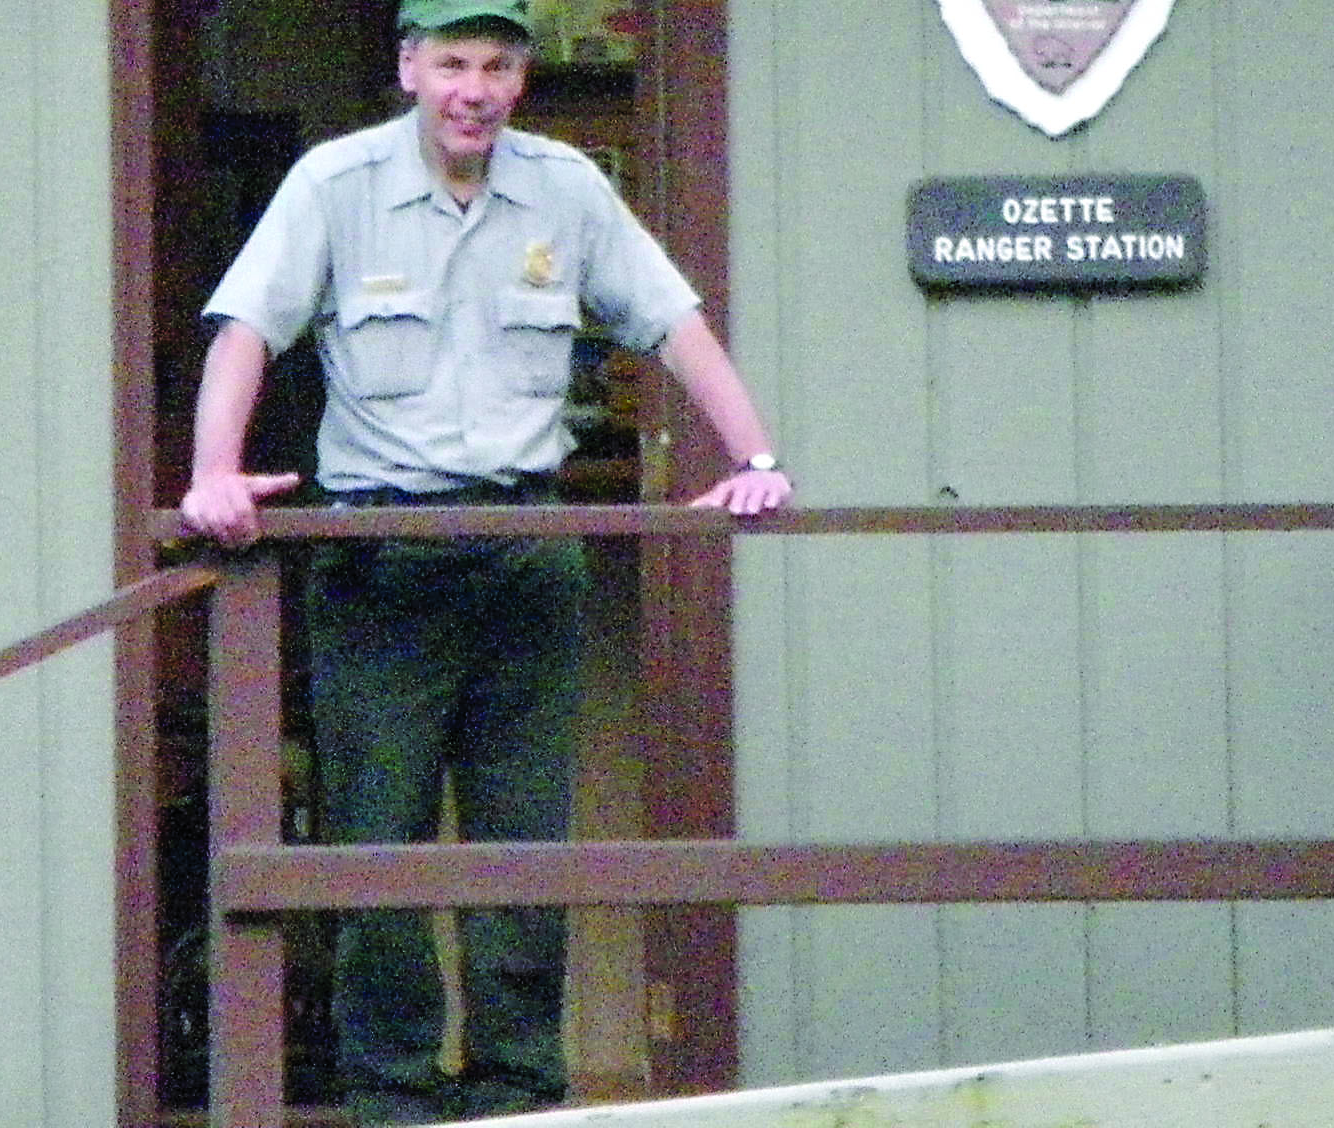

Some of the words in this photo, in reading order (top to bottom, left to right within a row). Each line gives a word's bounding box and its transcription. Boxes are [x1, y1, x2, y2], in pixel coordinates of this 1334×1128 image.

[1002, 197, 1116, 224] OZETTE
[933, 235, 1053, 263] RANGER
[1066, 233, 1185, 261] STATION
